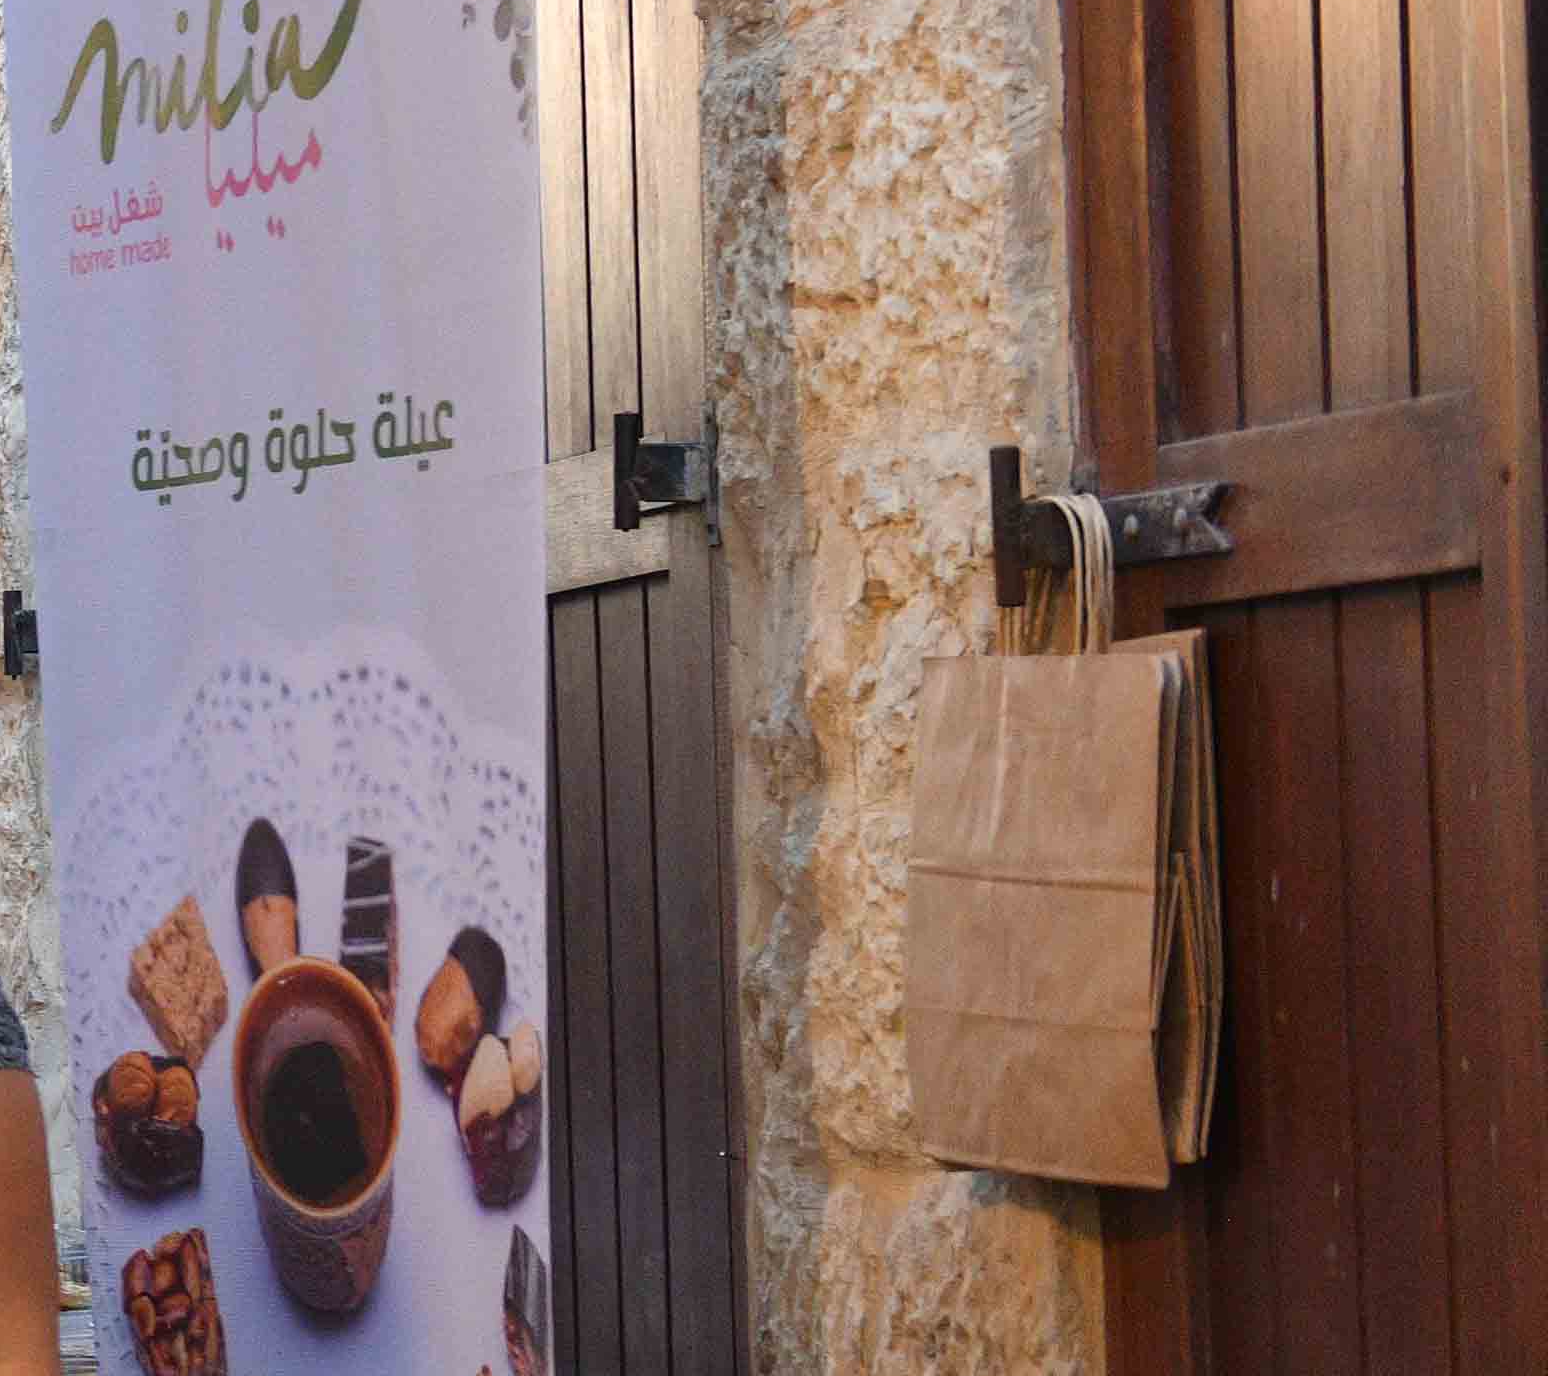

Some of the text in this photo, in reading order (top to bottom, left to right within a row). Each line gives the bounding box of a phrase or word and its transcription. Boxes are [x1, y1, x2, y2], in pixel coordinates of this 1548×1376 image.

[69, 233, 172, 276] home made
[265, 407, 356, 495] حلوة
[373, 392, 453, 472] عيلة
